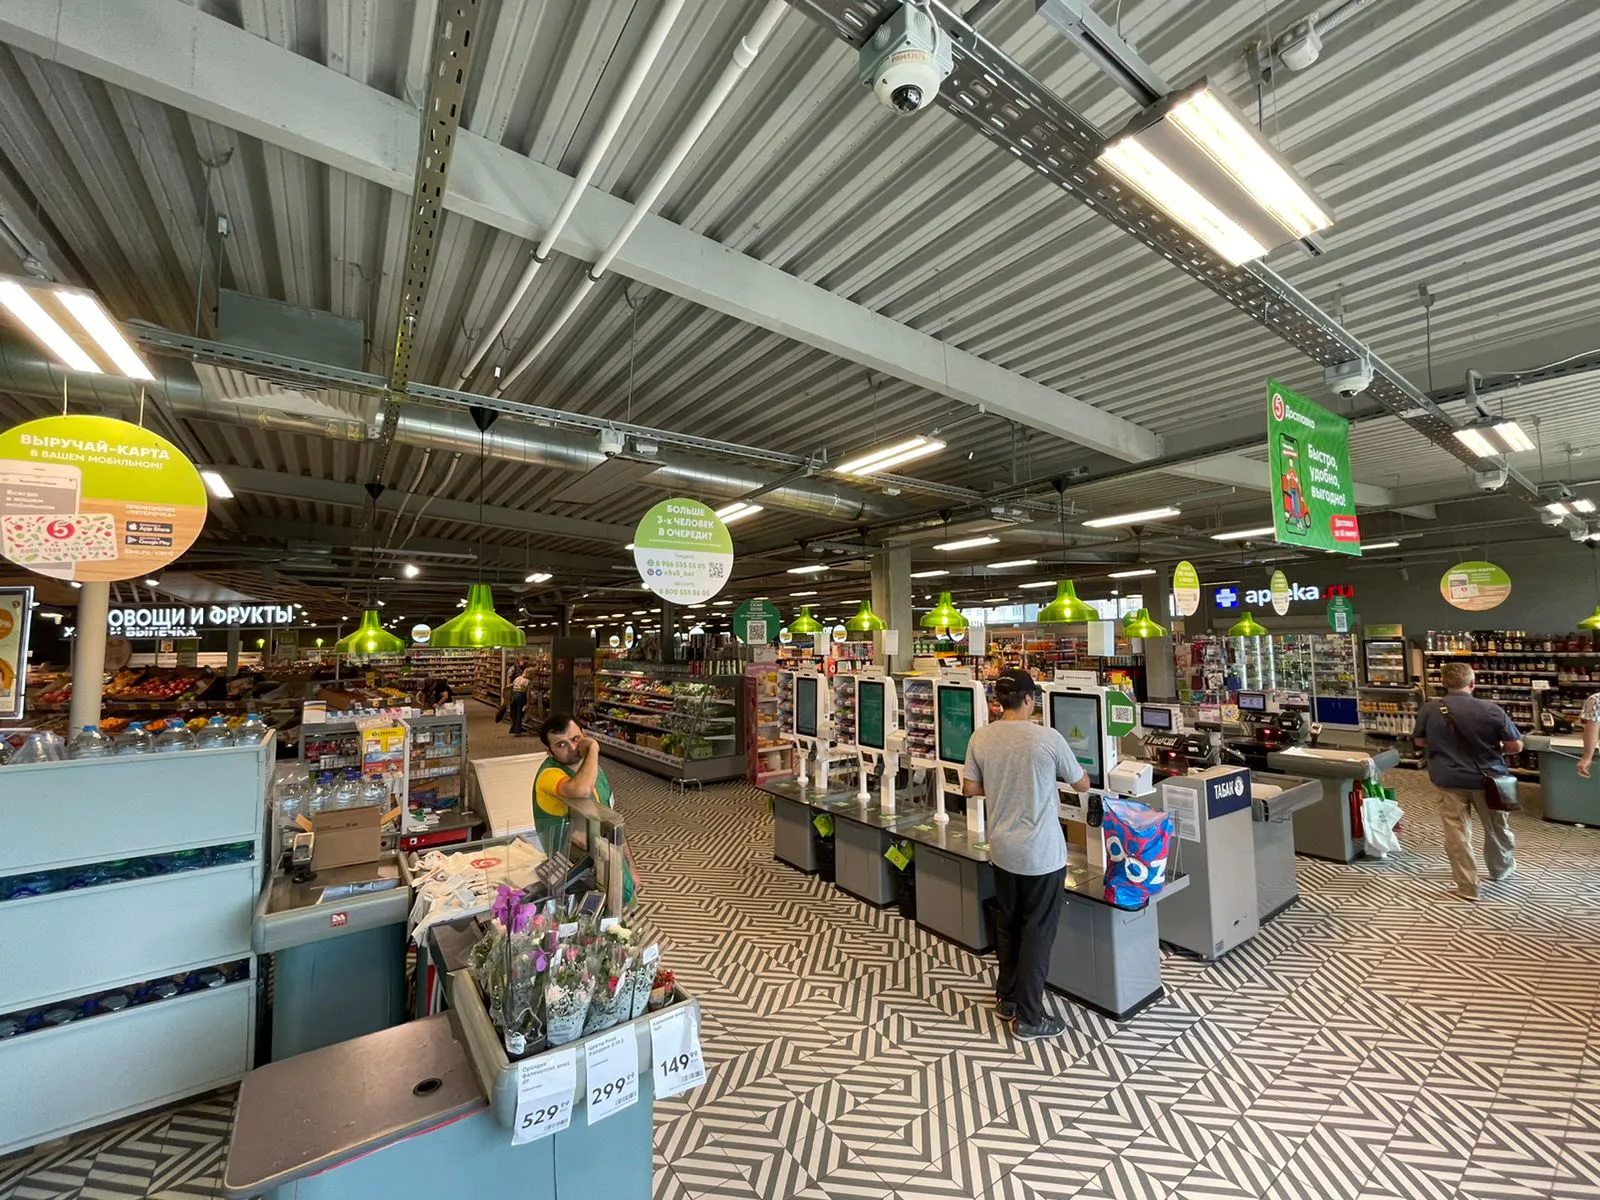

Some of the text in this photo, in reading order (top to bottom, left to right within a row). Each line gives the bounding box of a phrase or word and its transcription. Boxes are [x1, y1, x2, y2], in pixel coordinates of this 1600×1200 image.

[1285, 404, 1316, 430] Доставка
[20, 434, 170, 460] ВЫРУЧАЙ-КАРТА
[1307, 443, 1338, 471] Быстро,
[42, 451, 85, 462] ВАШЕМ
[88, 455, 163, 470] МОБИЛЬНОМ!
[1309, 464, 1341, 490] удобно,
[1311, 486, 1347, 507] выгодно!
[667, 504, 705, 516] БОЛЬШЕ
[658, 527, 713, 540] В ОЧЕРЕДИ?
[674, 517, 714, 529] ЧЕЛОВЕК
[1245, 582, 1354, 607] apeka.ru
[108, 605, 294, 629] ОВОЩИ И ФРУКТЫ
[1213, 780, 1235, 800] ТАБАК
[660, 1050, 698, 1077] 149 99
[591, 1071, 636, 1106] 299 99
[521, 1100, 570, 1129] 529 99
